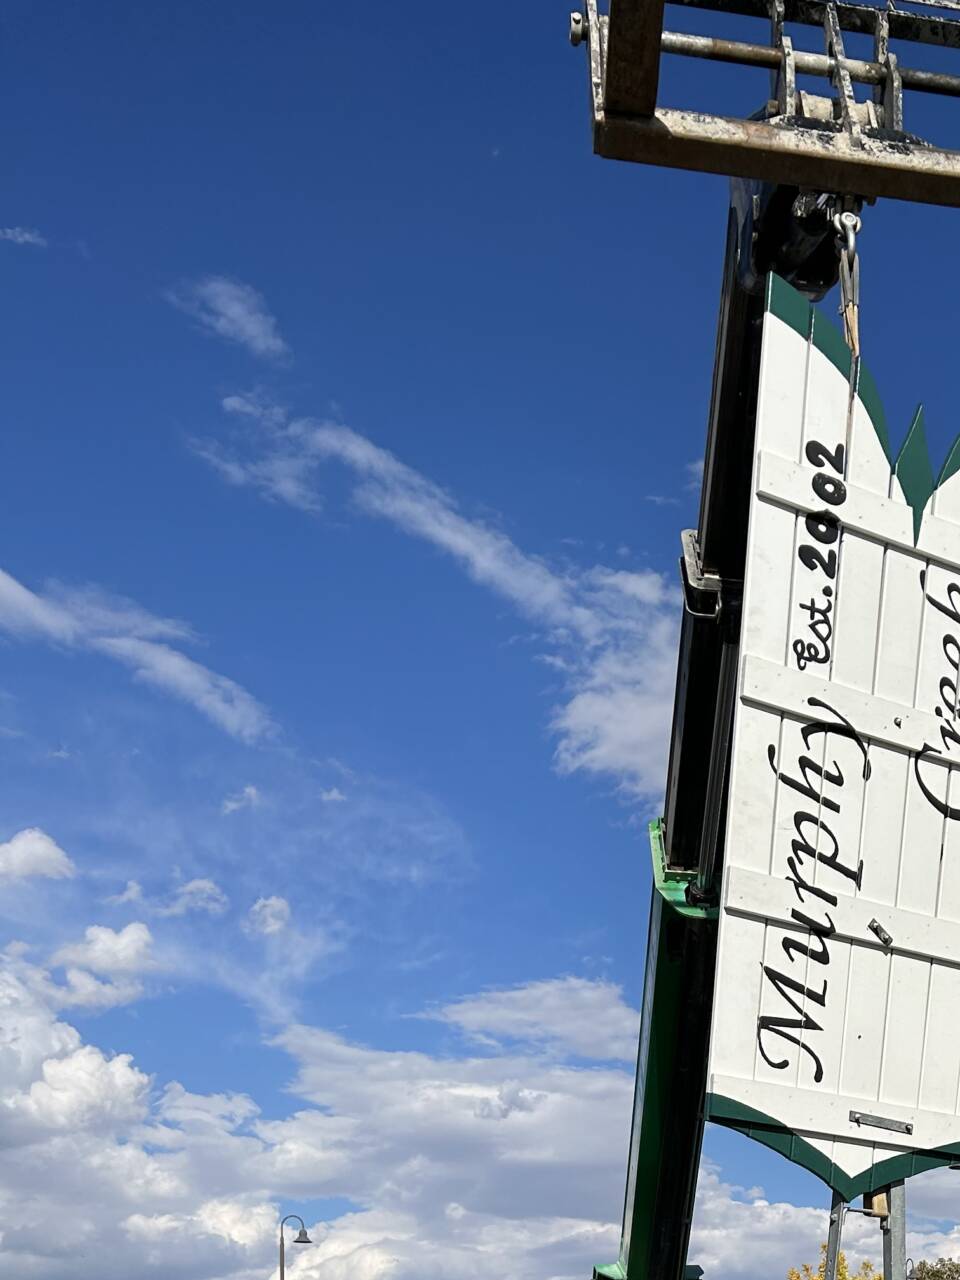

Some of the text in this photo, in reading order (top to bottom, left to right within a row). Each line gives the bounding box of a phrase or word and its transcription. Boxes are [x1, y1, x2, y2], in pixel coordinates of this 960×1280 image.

[792, 439, 848, 671] Est. 2002
[756, 696, 872, 1084] Murphy
